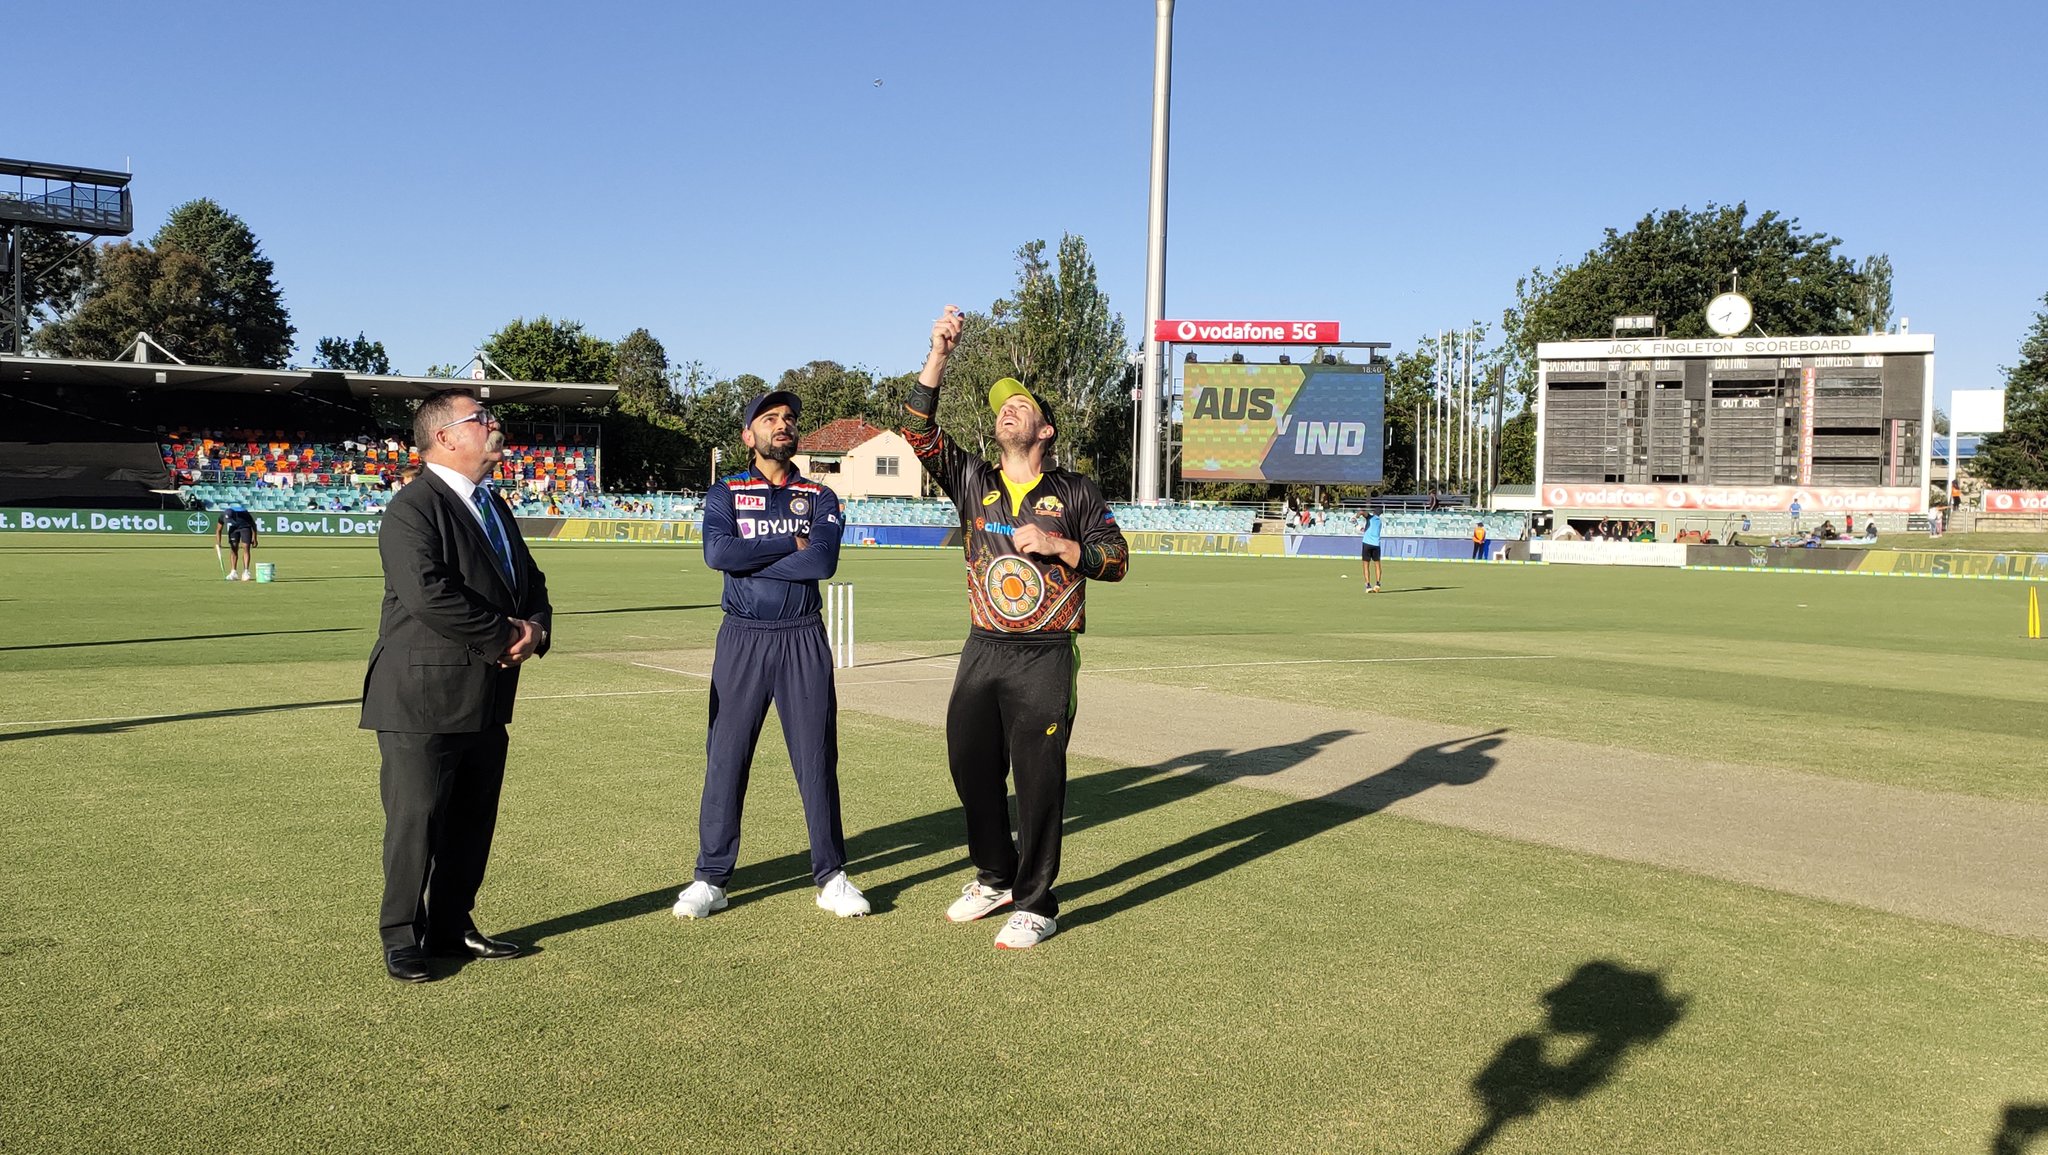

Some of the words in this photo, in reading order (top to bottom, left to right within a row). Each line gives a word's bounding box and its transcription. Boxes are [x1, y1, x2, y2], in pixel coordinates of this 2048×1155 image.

[1198, 324, 1285, 339] vodafone
[1291, 324, 1317, 340] 5G
[1608, 344, 1642, 354] JACK
[1653, 342, 1733, 353] FINGLETON
[1745, 340, 1851, 352] SCOREBOARD
[1362, 366, 1382, 374] 18:40
[1807, 378, 1814, 388] 2
[1807, 388, 1814, 397] 3
[1193, 387, 1275, 421] AUS
[1721, 399, 1739, 408] OUT
[1743, 399, 1760, 408] FOR
[1806, 398, 1814, 407] 4
[1806, 407, 1813, 417] 5
[1276, 414, 1292, 435] V
[1805, 417, 1813, 427] 6
[1294, 422, 1366, 456] IND
[1805, 427, 1813, 436] 7
[737, 495, 764, 506] MPL
[1575, 489, 1655, 505] vodafone
[1695, 490, 1778, 506] vodafone
[1820, 492, 1912, 508] vodafone
[21, 512, 86, 529] Bowl.
[90, 513, 173, 531] Dettol.
[276, 517, 335, 534] Bowl.
[757, 519, 811, 535] BYJU'S
[1130, 534, 1250, 554] AUSTRALIA
[1892, 554, 2048, 578] AUSTRALIA
